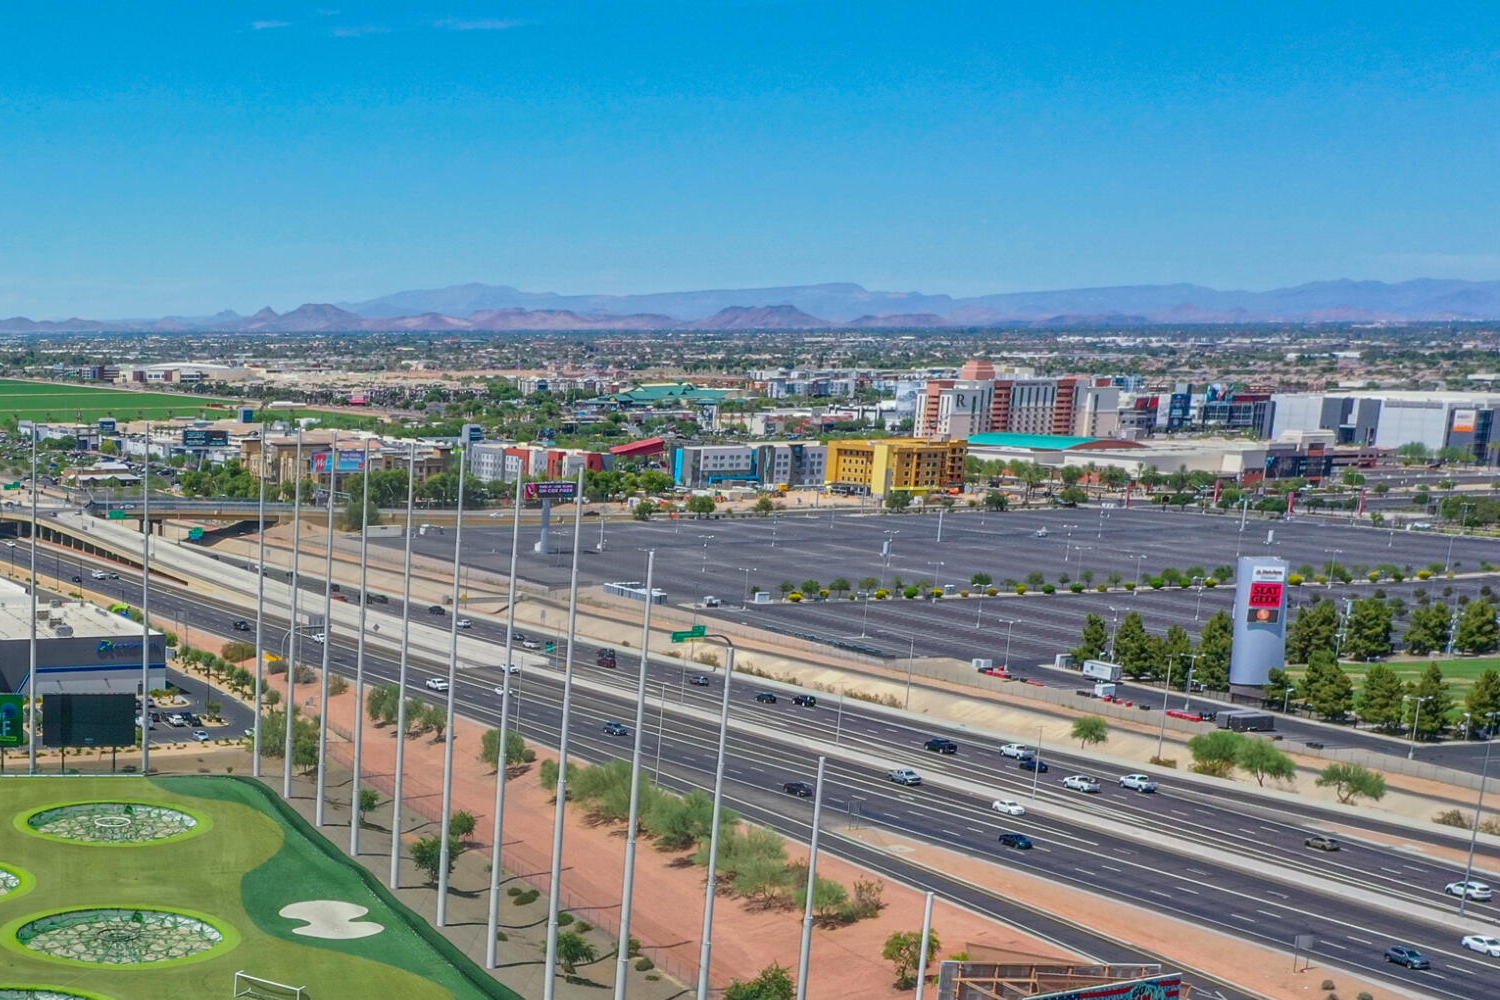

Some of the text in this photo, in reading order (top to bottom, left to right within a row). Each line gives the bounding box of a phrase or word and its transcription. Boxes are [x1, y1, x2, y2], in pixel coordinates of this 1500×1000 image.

[956, 394, 967, 407] R
[1253, 586, 1279, 594] SEAT
[1251, 595, 1279, 604] GEEK
[1132, 985, 1146, 998] GO
